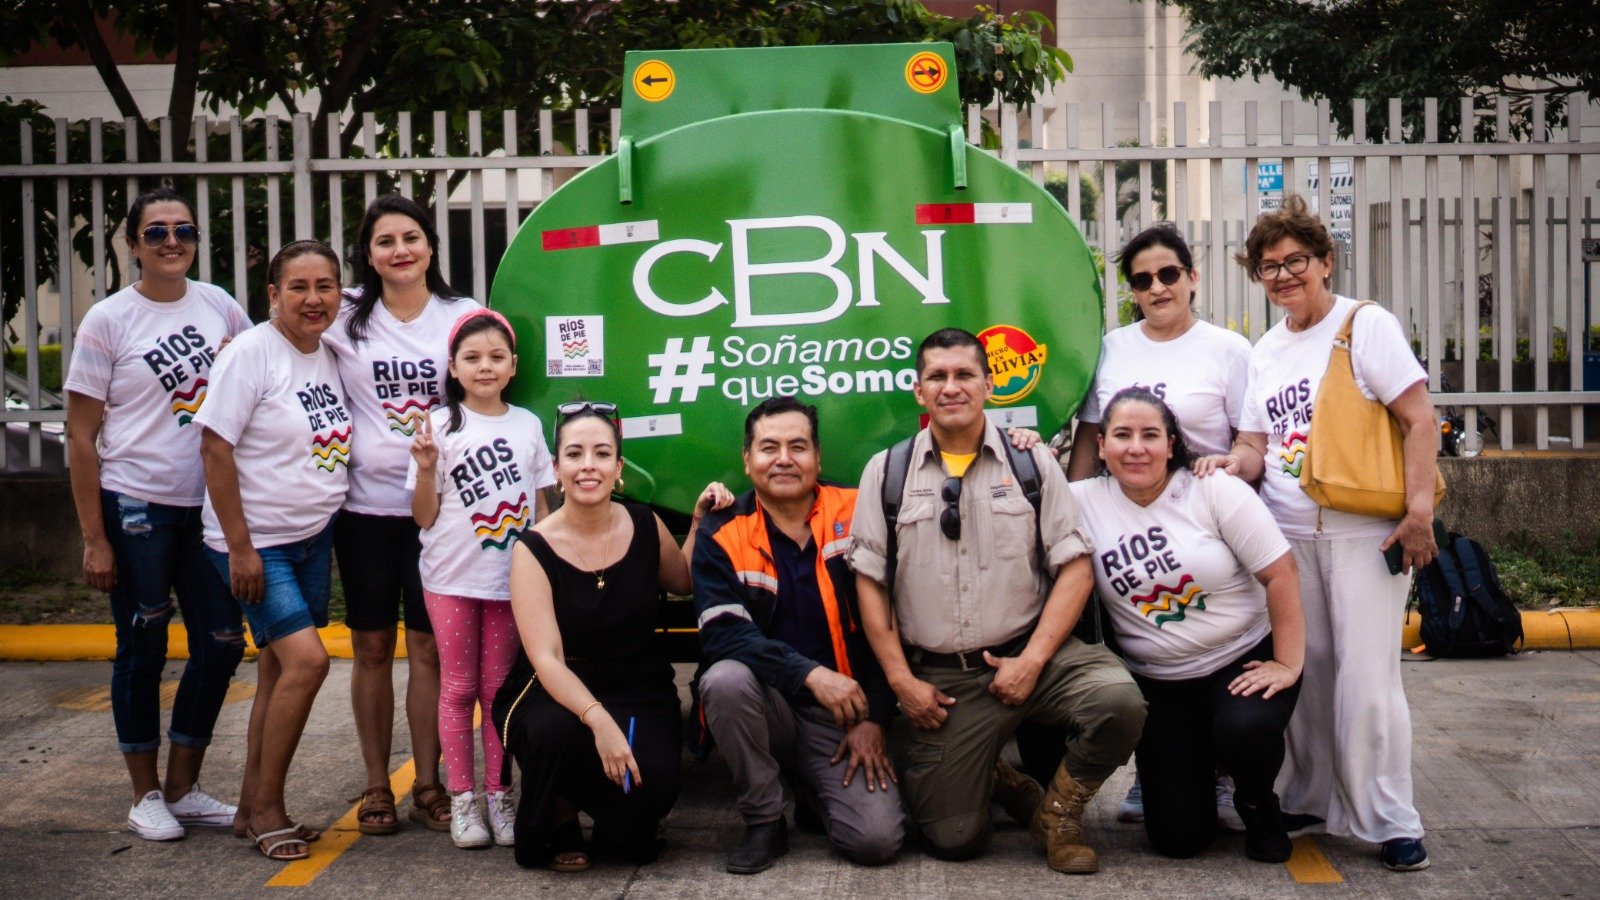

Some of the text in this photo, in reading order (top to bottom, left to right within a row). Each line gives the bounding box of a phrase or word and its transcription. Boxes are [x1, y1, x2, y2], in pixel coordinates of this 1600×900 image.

[1331, 195, 1352, 205] EATONES
[632, 215, 950, 328] CBN
[559, 319, 585, 333] RÍOS
[561, 330, 586, 342] DE PIE
[143, 325, 205, 376] RÍOS
[993, 352, 1038, 375] LIVIA
[159, 363, 189, 392] DE
[372, 356, 437, 382] RÍOS
[296, 381, 338, 412] RÍOS
[375, 380, 438, 399] DE PIE
[722, 364, 918, 406] queSomo
[1266, 377, 1310, 423] RÍOS
[308, 405, 349, 432] DE PIE
[1293, 402, 1312, 428] PIE
[450, 437, 513, 490] RÍOS
[459, 462, 522, 508] DE PIE
[1100, 525, 1168, 578] RÍOS
[1110, 549, 1182, 597] DE PIE
